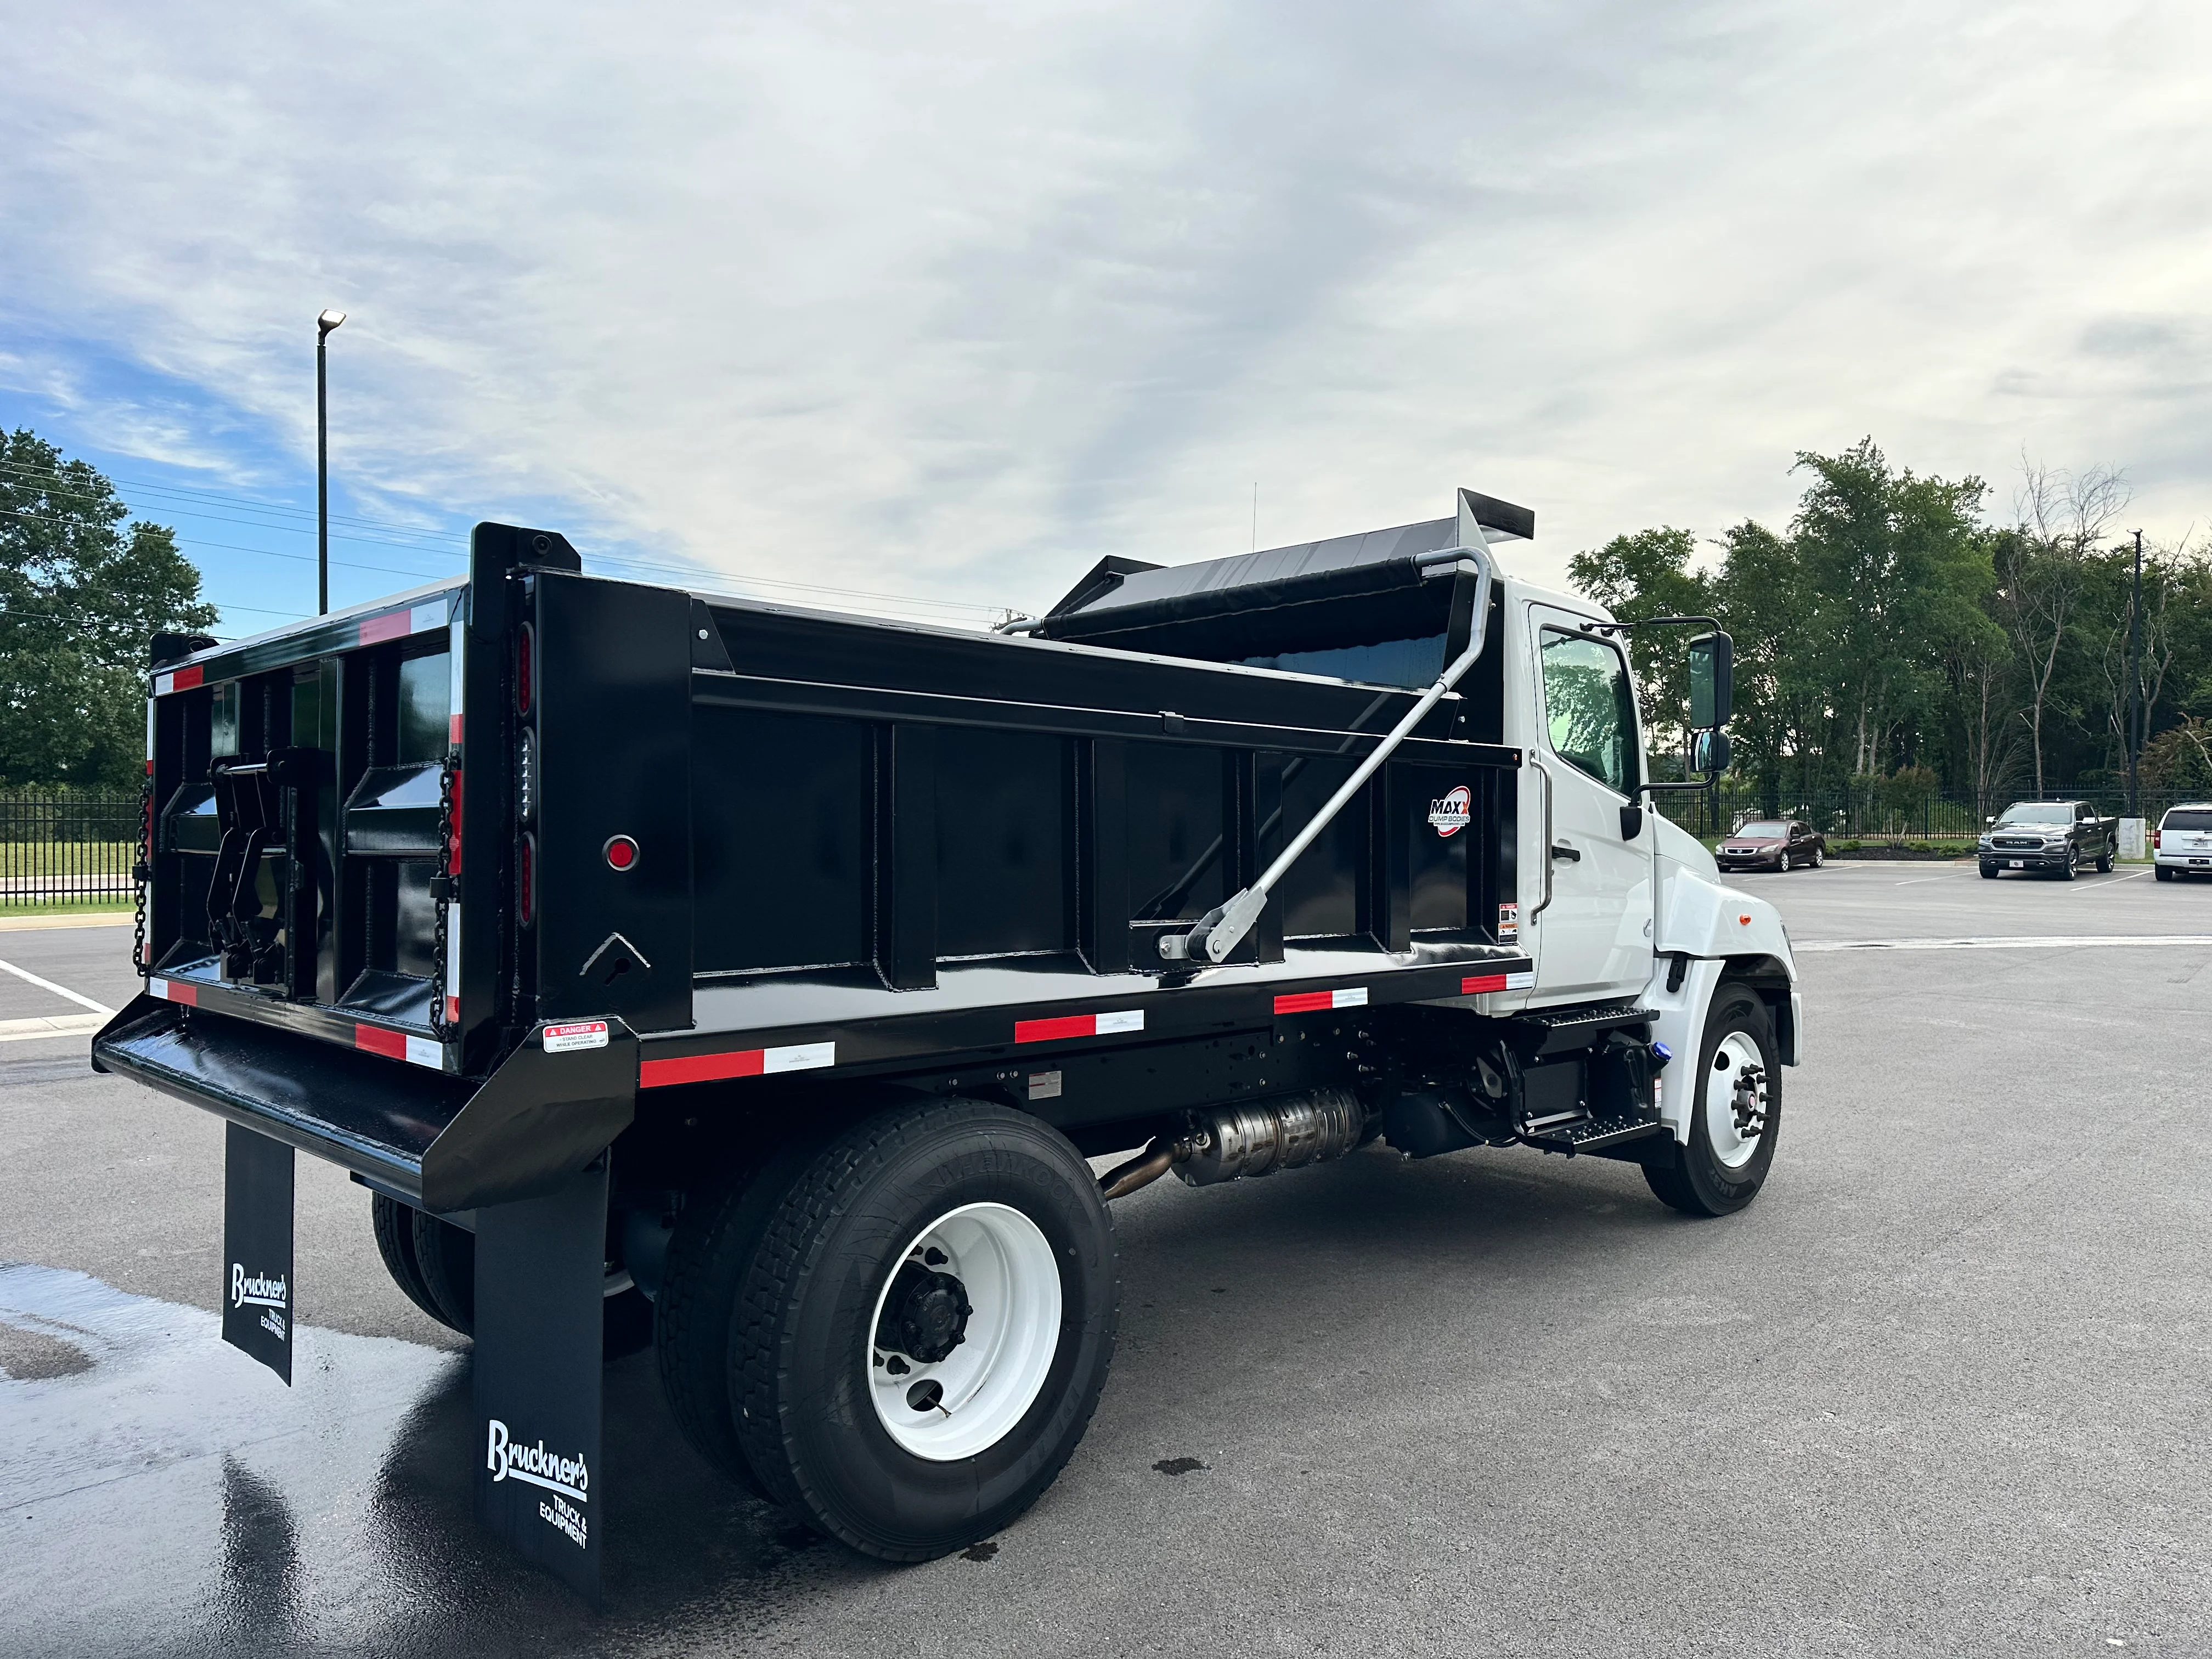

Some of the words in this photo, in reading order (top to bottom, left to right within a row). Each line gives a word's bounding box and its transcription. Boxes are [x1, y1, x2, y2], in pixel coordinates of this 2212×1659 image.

[1431, 800, 1468, 814] MAXX
[560, 1026, 591, 1035] DANGER
[231, 1263, 286, 1308] Bruckner's
[261, 1315, 285, 1342] EQUIPMENT
[268, 1308, 283, 1328] TRUCK
[488, 1419, 588, 1491] Bruckner's
[539, 1501, 587, 1549] EQUIPMENT
[553, 1494, 580, 1528] TRUCK
[581, 1517, 587, 1534] &
